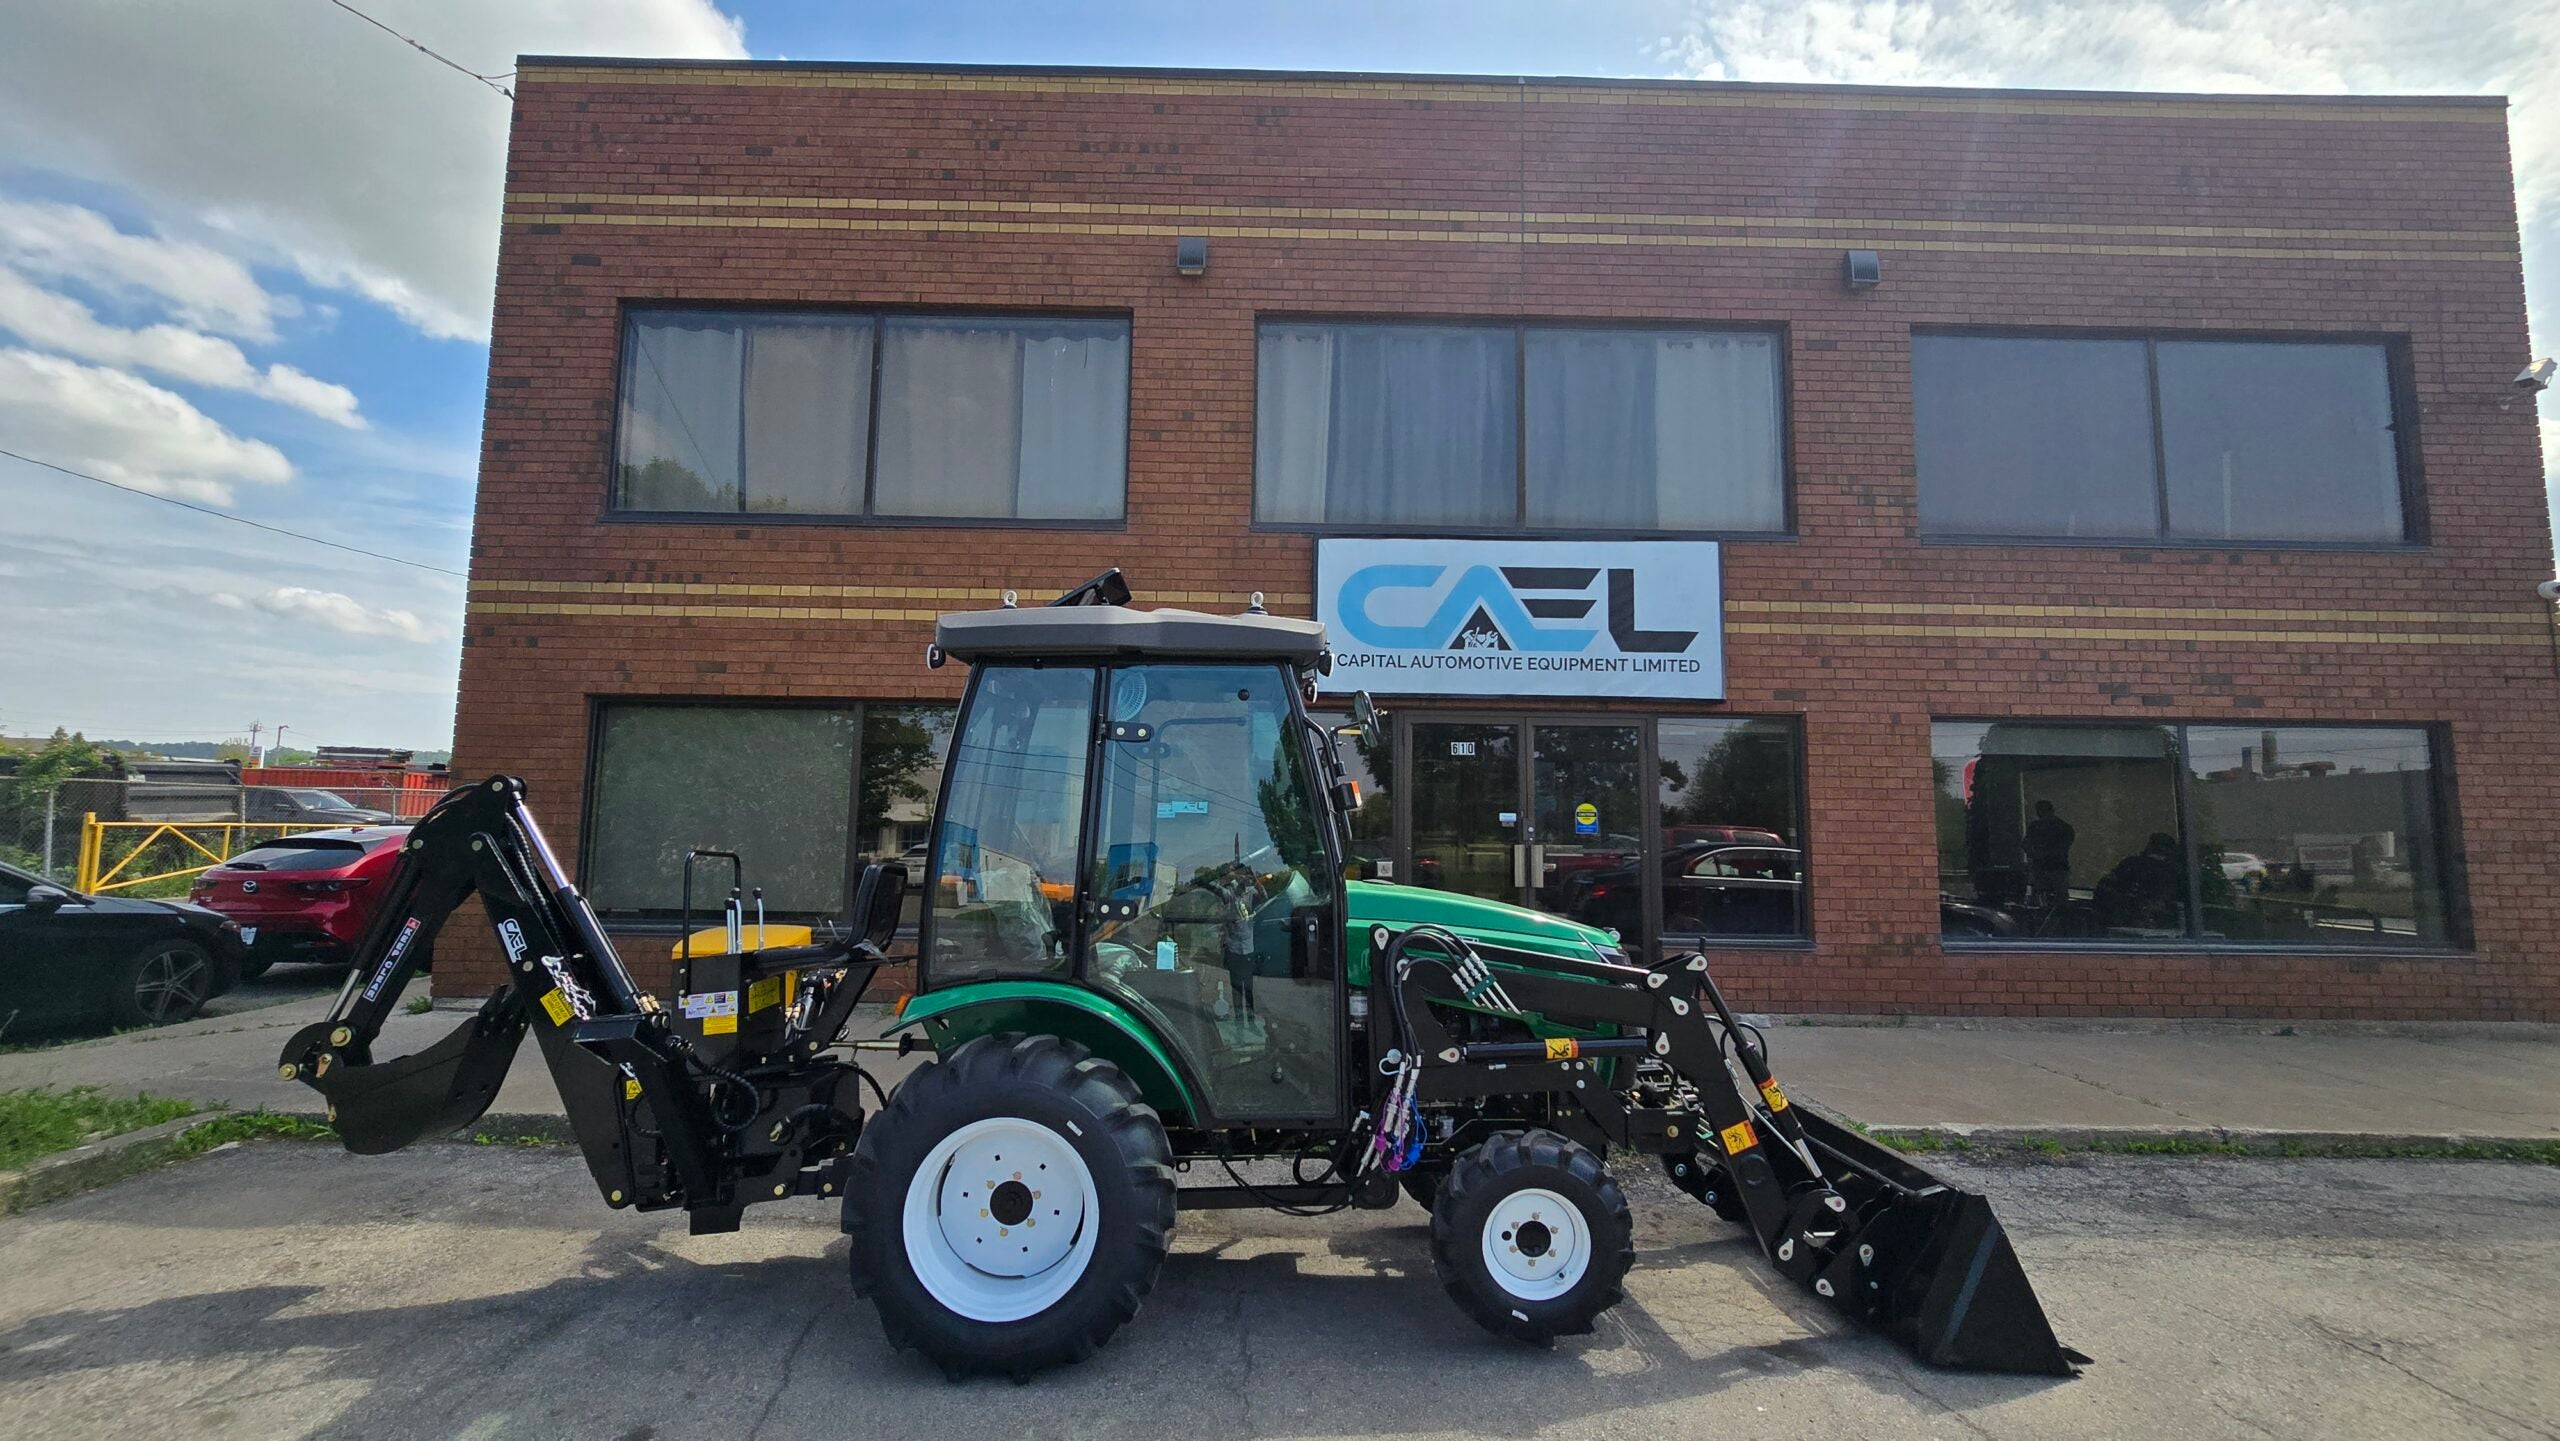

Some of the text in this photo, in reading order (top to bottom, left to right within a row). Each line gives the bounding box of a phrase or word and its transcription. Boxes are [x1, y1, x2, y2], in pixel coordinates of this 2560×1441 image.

[1337, 564, 1699, 653] CAEL
[1336, 653, 1700, 673] CAPITAL AUTOMOTIVE EQUIPMENT LIMITED
[1452, 743, 1474, 754] 610
[366, 927, 413, 999] KEEP CLEAR
